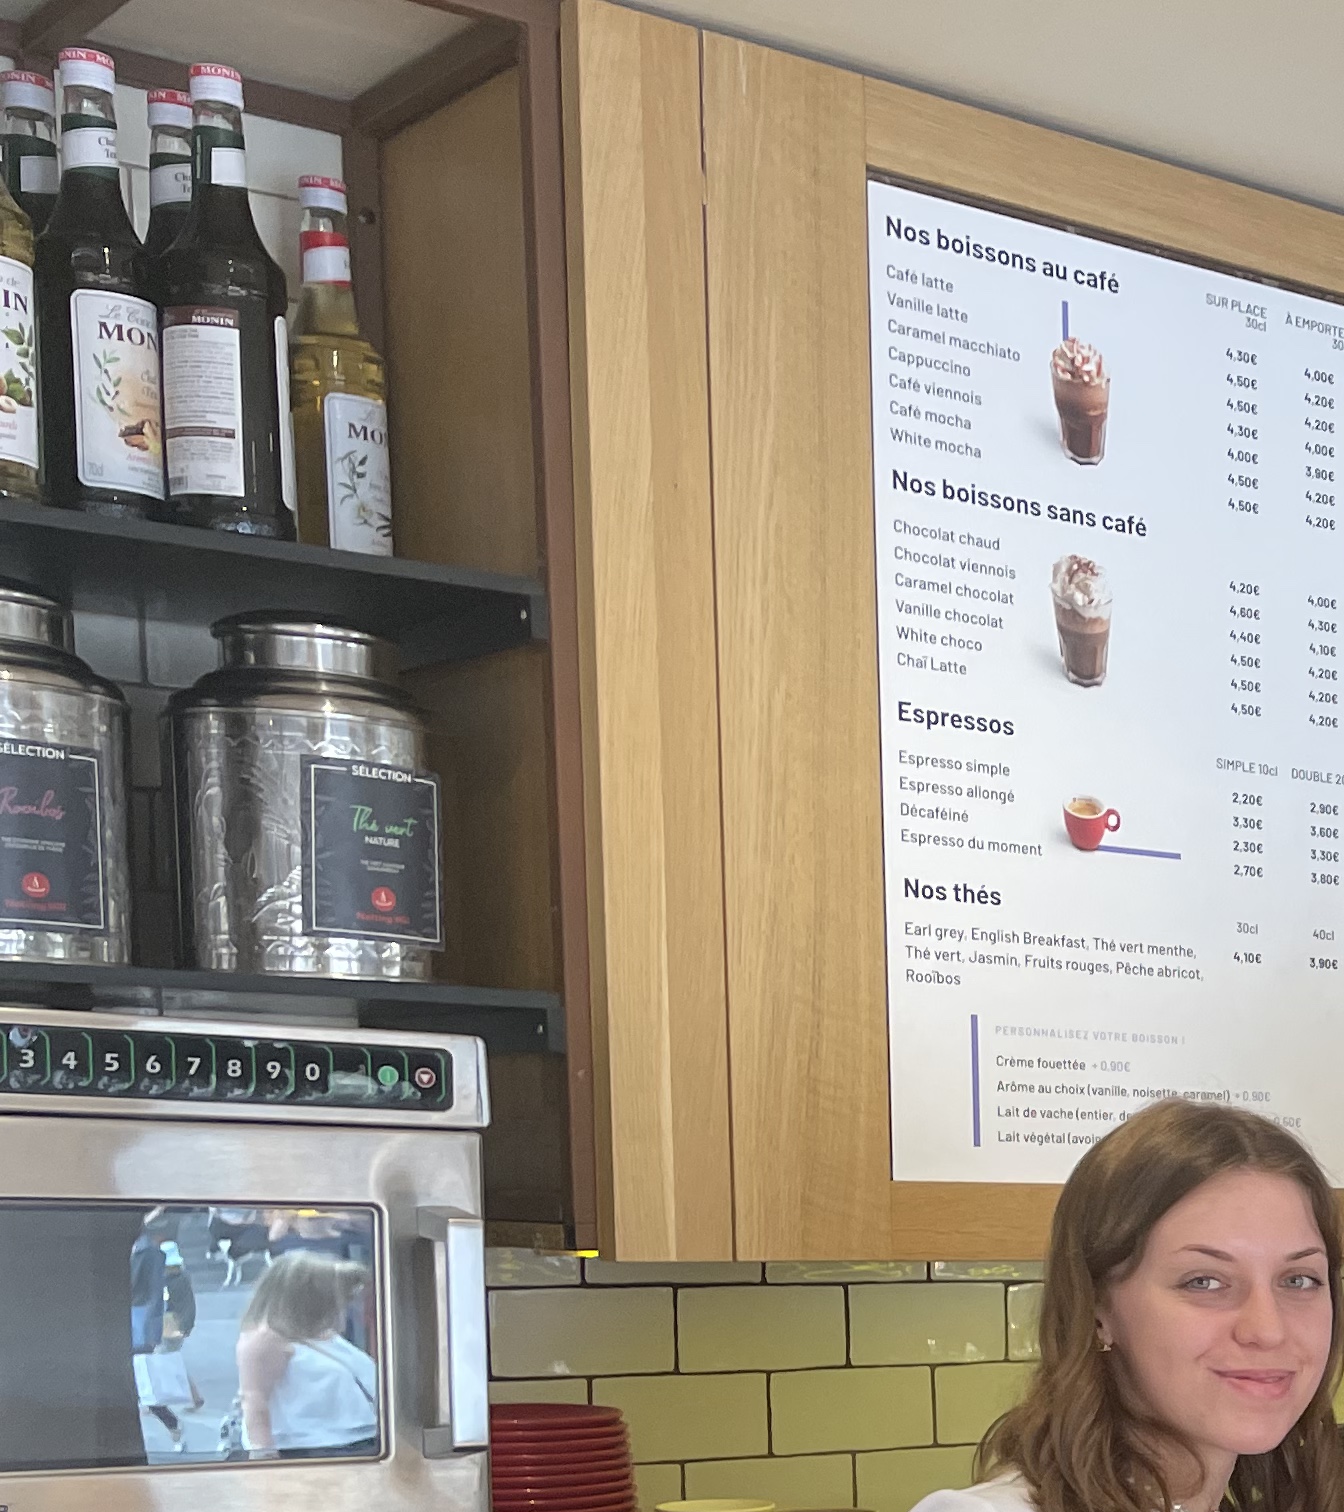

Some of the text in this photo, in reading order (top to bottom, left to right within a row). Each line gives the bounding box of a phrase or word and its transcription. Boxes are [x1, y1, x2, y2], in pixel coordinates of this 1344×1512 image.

[886, 216, 1119, 293] Nos boissons au café
[887, 265, 954, 292] Café latte
[887, 291, 968, 323] Vanille latte
[1206, 293, 1267, 319] SUR PLACE
[191, 316, 234, 326] MONIN
[1245, 317, 1266, 332] 30cl
[1285, 311, 1293, 326] À
[888, 319, 1020, 361] Caramel macchiato
[888, 346, 971, 376] Cappuccino
[1226, 348, 1257, 365] 4,30€
[1304, 368, 1334, 385] 4,00€
[889, 373, 982, 406] Café viennois
[890, 400, 971, 430] Café mocha
[890, 428, 982, 458] White mocha
[892, 469, 1147, 536] Nos boissons sans café
[893, 520, 1000, 550] Chocolat chaud
[894, 546, 1016, 580] Chocolat viennois
[895, 573, 1014, 604] Caramel chocolat
[1229, 581, 1260, 596] 4,20€
[896, 599, 1003, 629] Vanille chocolat
[896, 626, 983, 651] White choco
[897, 652, 967, 675] Chaï Latte
[898, 701, 1014, 735] Espressos
[352, 765, 412, 783] SÉLECTION
[899, 750, 1010, 778] Espresso simple
[1216, 758, 1278, 777] SIMPLE 10cl
[1291, 768, 1332, 784] DOUBLE
[900, 776, 1014, 804] Espresso allongé
[1232, 792, 1263, 806] 2,20€
[900, 802, 969, 822] Décaféiné
[1233, 817, 1263, 830] 3,30€
[365, 836, 400, 848] NATURE
[901, 829, 1043, 856] Espresso du moment
[1234, 865, 1263, 878] 2,70€
[904, 878, 1001, 905] Nos thés
[1236, 922, 1258, 934] 30cl
[1312, 930, 1334, 941] 40cl
[904, 922, 1197, 959] Earl grey, English Breakfast, Thé vert menthe,
[905, 945, 1204, 981] Thé vert, Jasmin, Fruits rouges, Pêche abricot,
[1233, 953, 1262, 964] 4,10€
[905, 969, 961, 986] Rooïbos
[19, 1049, 320, 1080] 3 4 5 6 7 8 9 0
[996, 1056, 1086, 1071] Crème fouettée
[997, 1081, 1035, 1094] Arôme
[1038, 1083, 1052, 1094] au
[1054, 1084, 1085, 1096] choix
[997, 1106, 1020, 1119] Lait
[1023, 1107, 1036, 1118] de
[1040, 1108, 1074, 1120] vache
[998, 1131, 1066, 1146] Lait végétal
